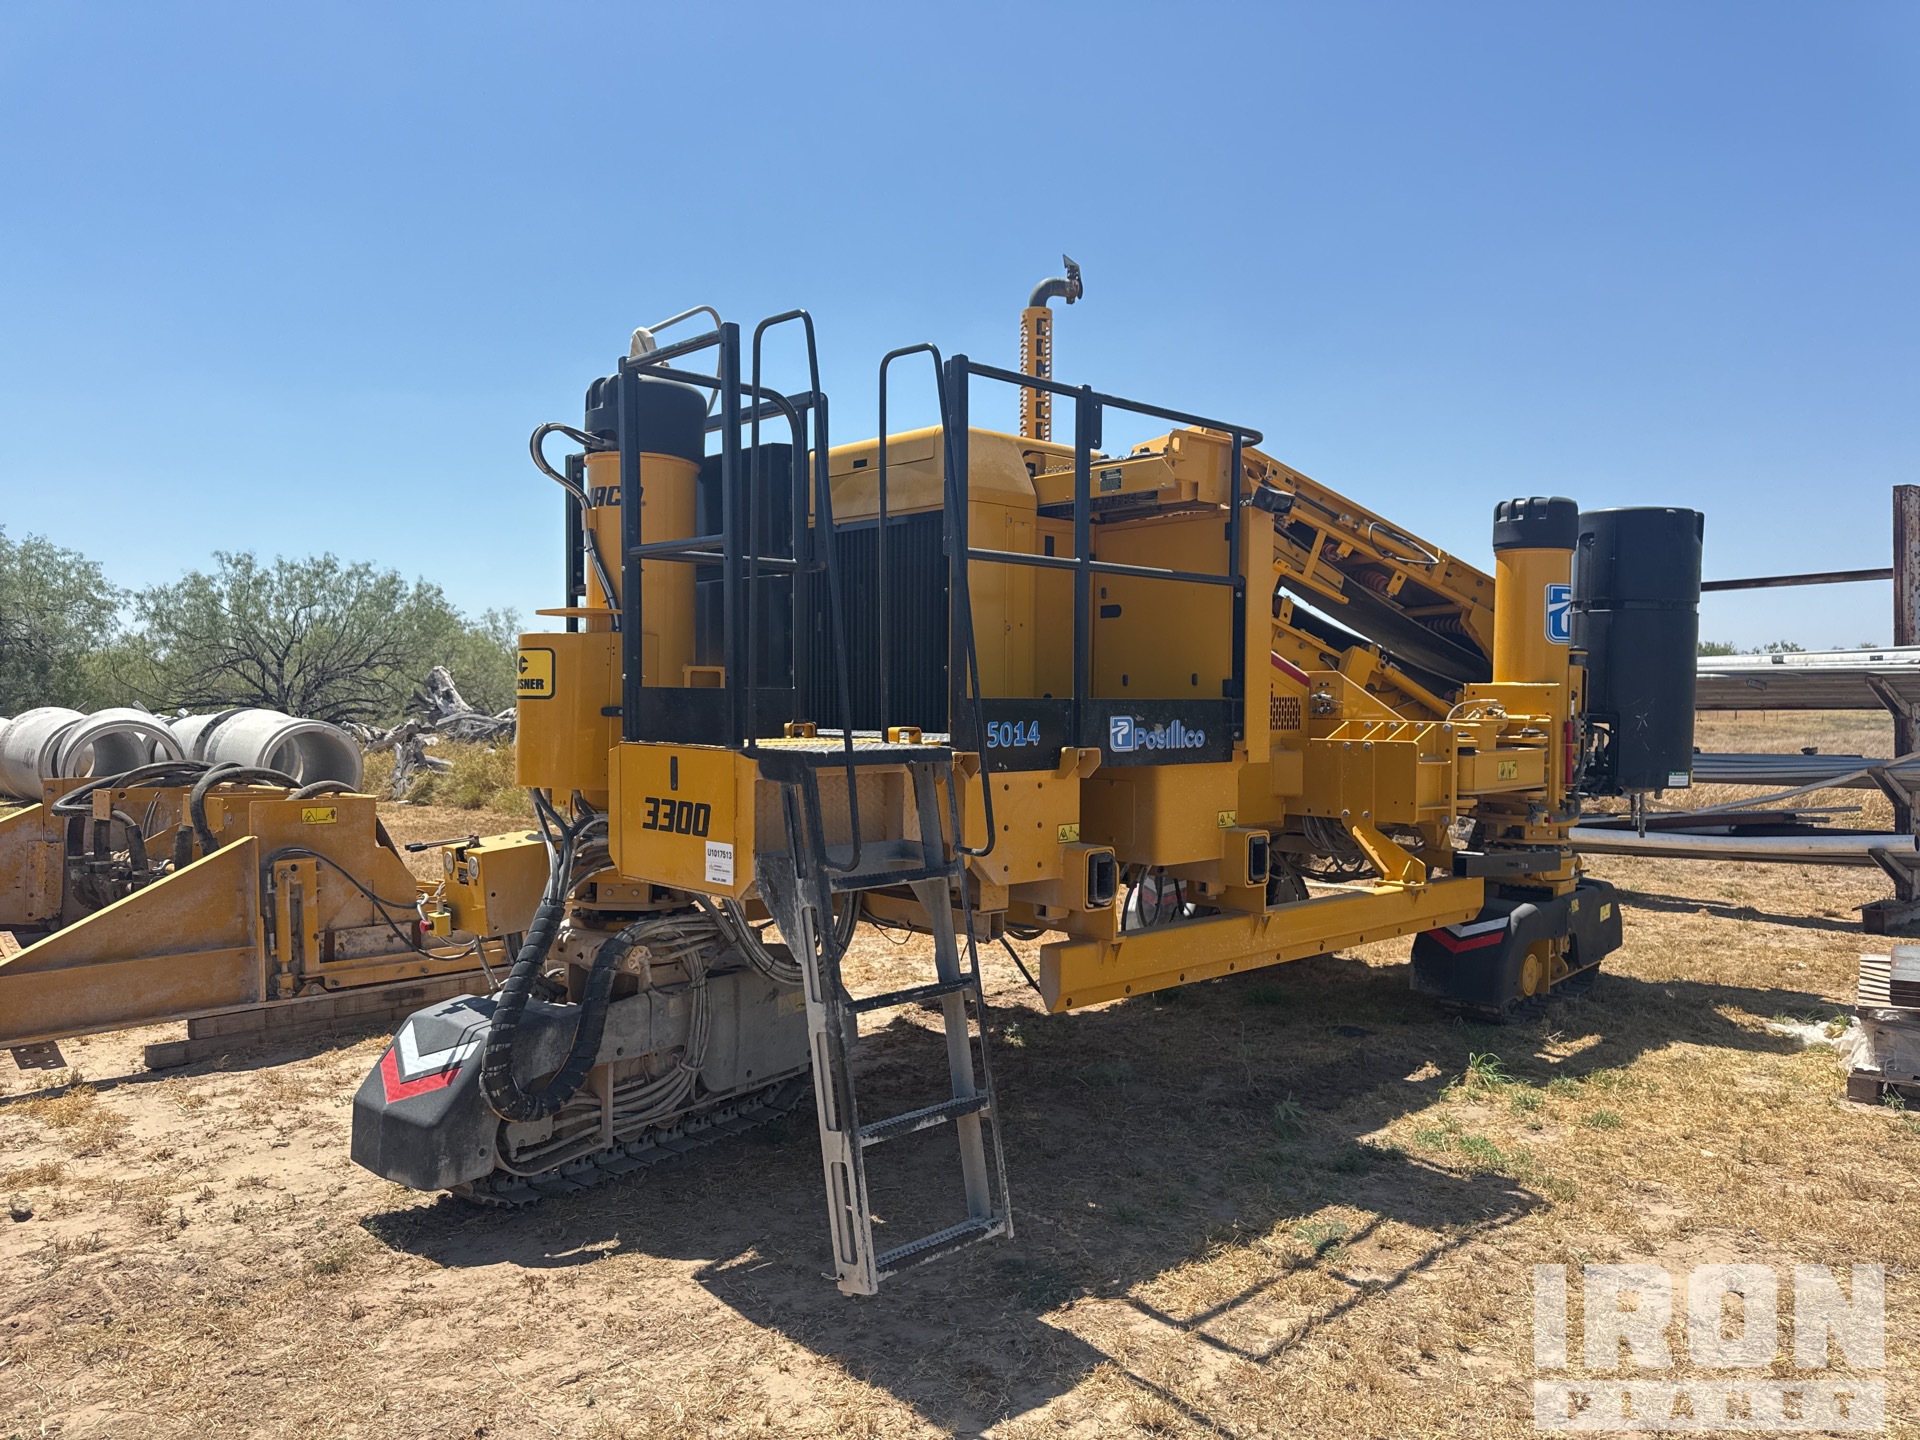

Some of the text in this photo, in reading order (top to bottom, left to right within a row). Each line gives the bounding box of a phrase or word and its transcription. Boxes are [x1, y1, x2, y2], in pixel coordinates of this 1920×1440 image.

[588, 486, 644, 507] AC
[986, 720, 1041, 748] 5014
[1134, 719, 1205, 751] Posillico
[642, 796, 712, 838] 3300
[707, 848, 733, 860] U1017513
